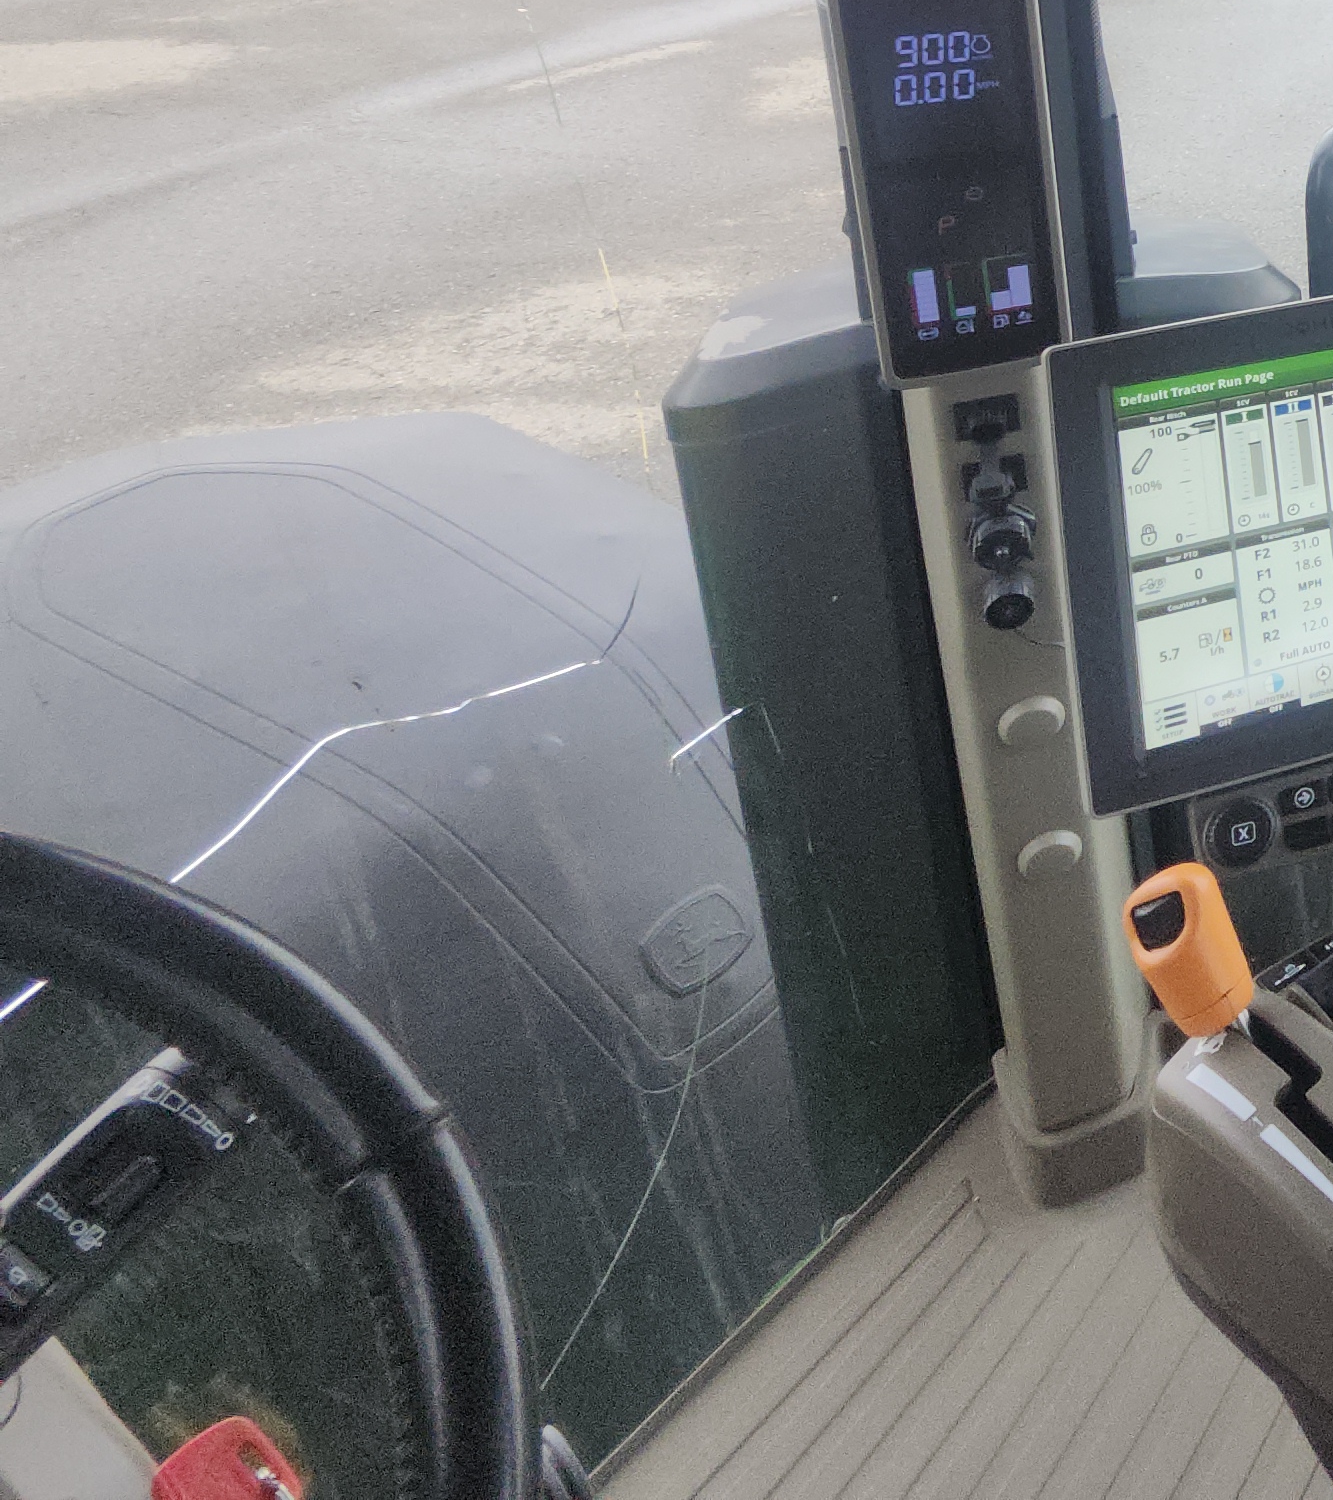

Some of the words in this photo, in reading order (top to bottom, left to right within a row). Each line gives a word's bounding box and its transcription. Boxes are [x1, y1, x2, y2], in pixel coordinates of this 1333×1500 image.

[895, 30, 971, 68] 900
[894, 69, 975, 107] 0.00
[1120, 388, 1168, 407] Default
[1169, 382, 1216, 398] Tractor
[1217, 377, 1242, 390] Run
[1244, 370, 1275, 386] Page
[1287, 402, 1299, 414] II
[1149, 426, 1172, 438] 100
[1127, 480, 1163, 496] 100%
[1175, 533, 1184, 543] 0
[1254, 547, 1271, 561] F2
[1292, 537, 1320, 552] 31.0
[1194, 568, 1203, 580] 0
[1256, 568, 1272, 582] F1
[1295, 556, 1322, 572] 18.6
[1298, 579, 1322, 593] MPH
[1260, 609, 1277, 623] R1
[1303, 597, 1323, 613] 2.9
[1262, 629, 1281, 644] R2
[1302, 617, 1329, 634] 12.0
[1159, 647, 1180, 663] 5.7
[1279, 646, 1299, 662] Full
[1302, 641, 1331, 656] AUTO
